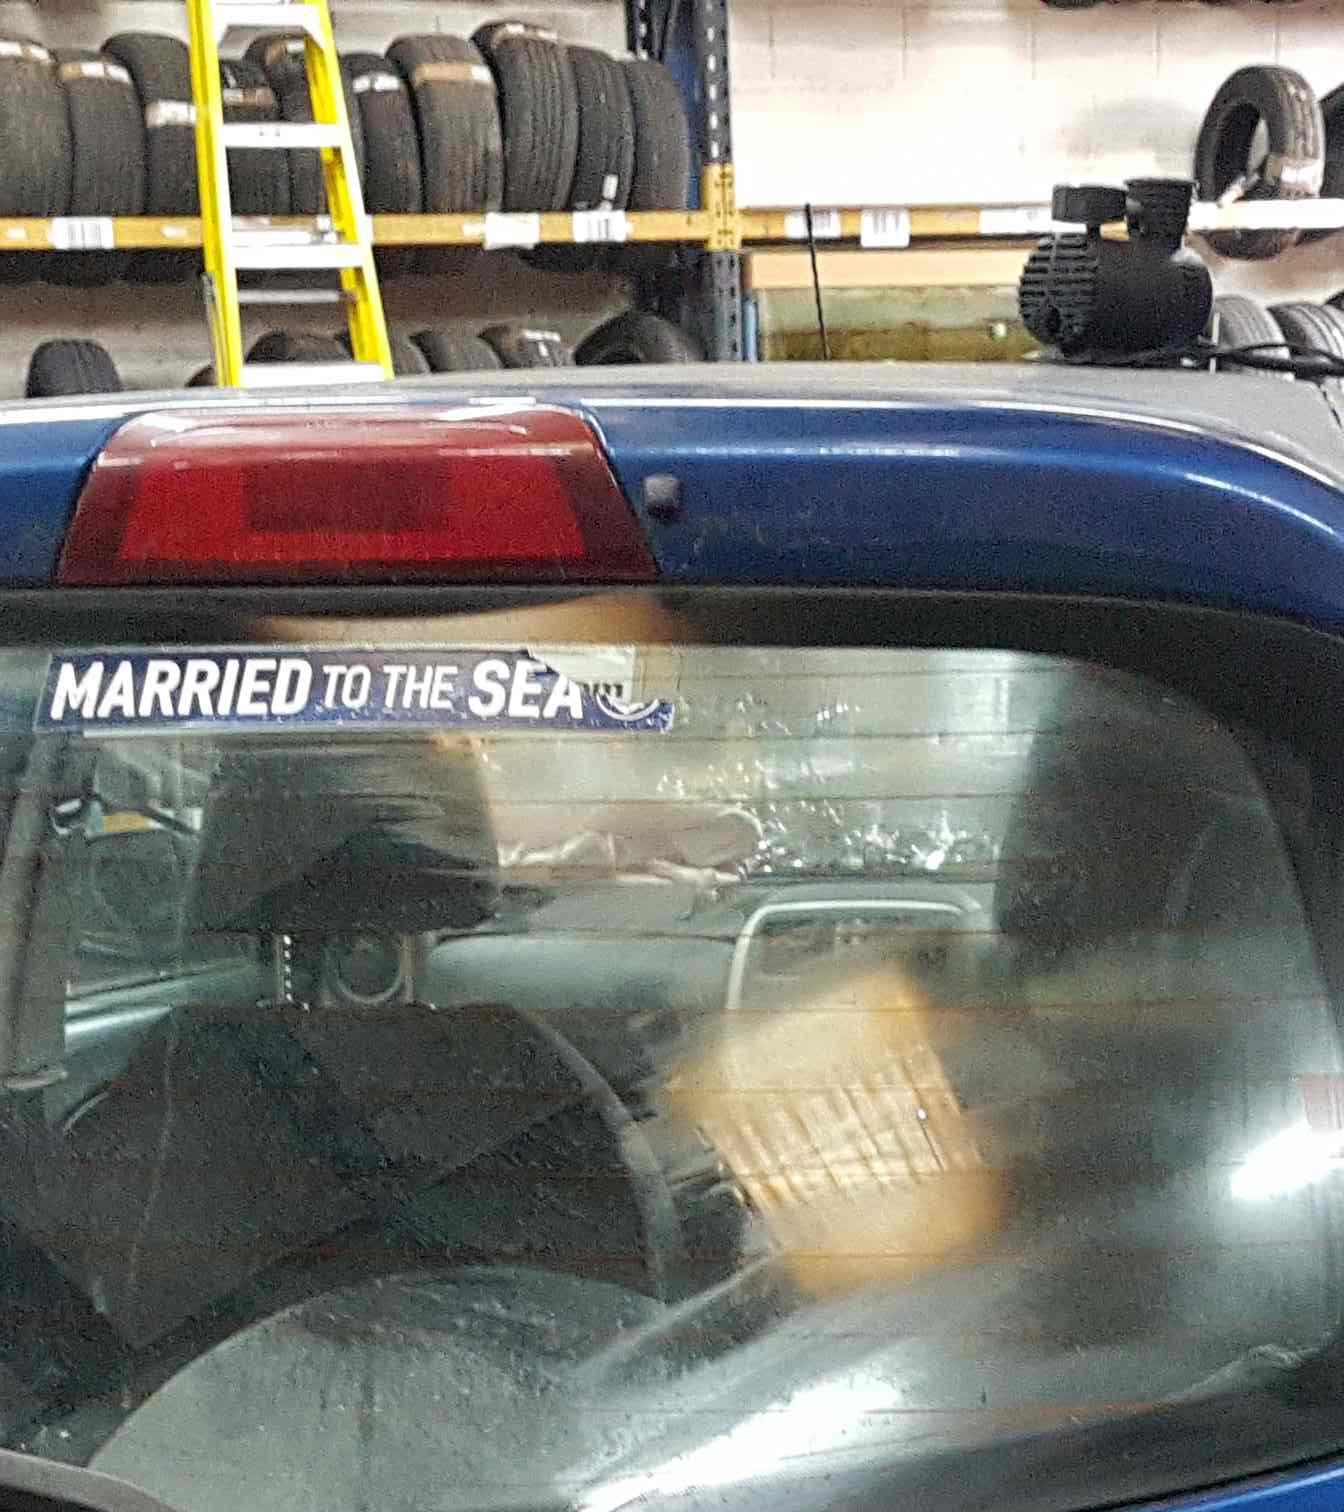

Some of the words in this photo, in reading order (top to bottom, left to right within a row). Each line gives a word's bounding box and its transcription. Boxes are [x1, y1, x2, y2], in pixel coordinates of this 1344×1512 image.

[49, 658, 312, 720] MARRIED
[322, 664, 370, 709] TO
[382, 664, 458, 710] THE
[468, 659, 584, 720] SEA
